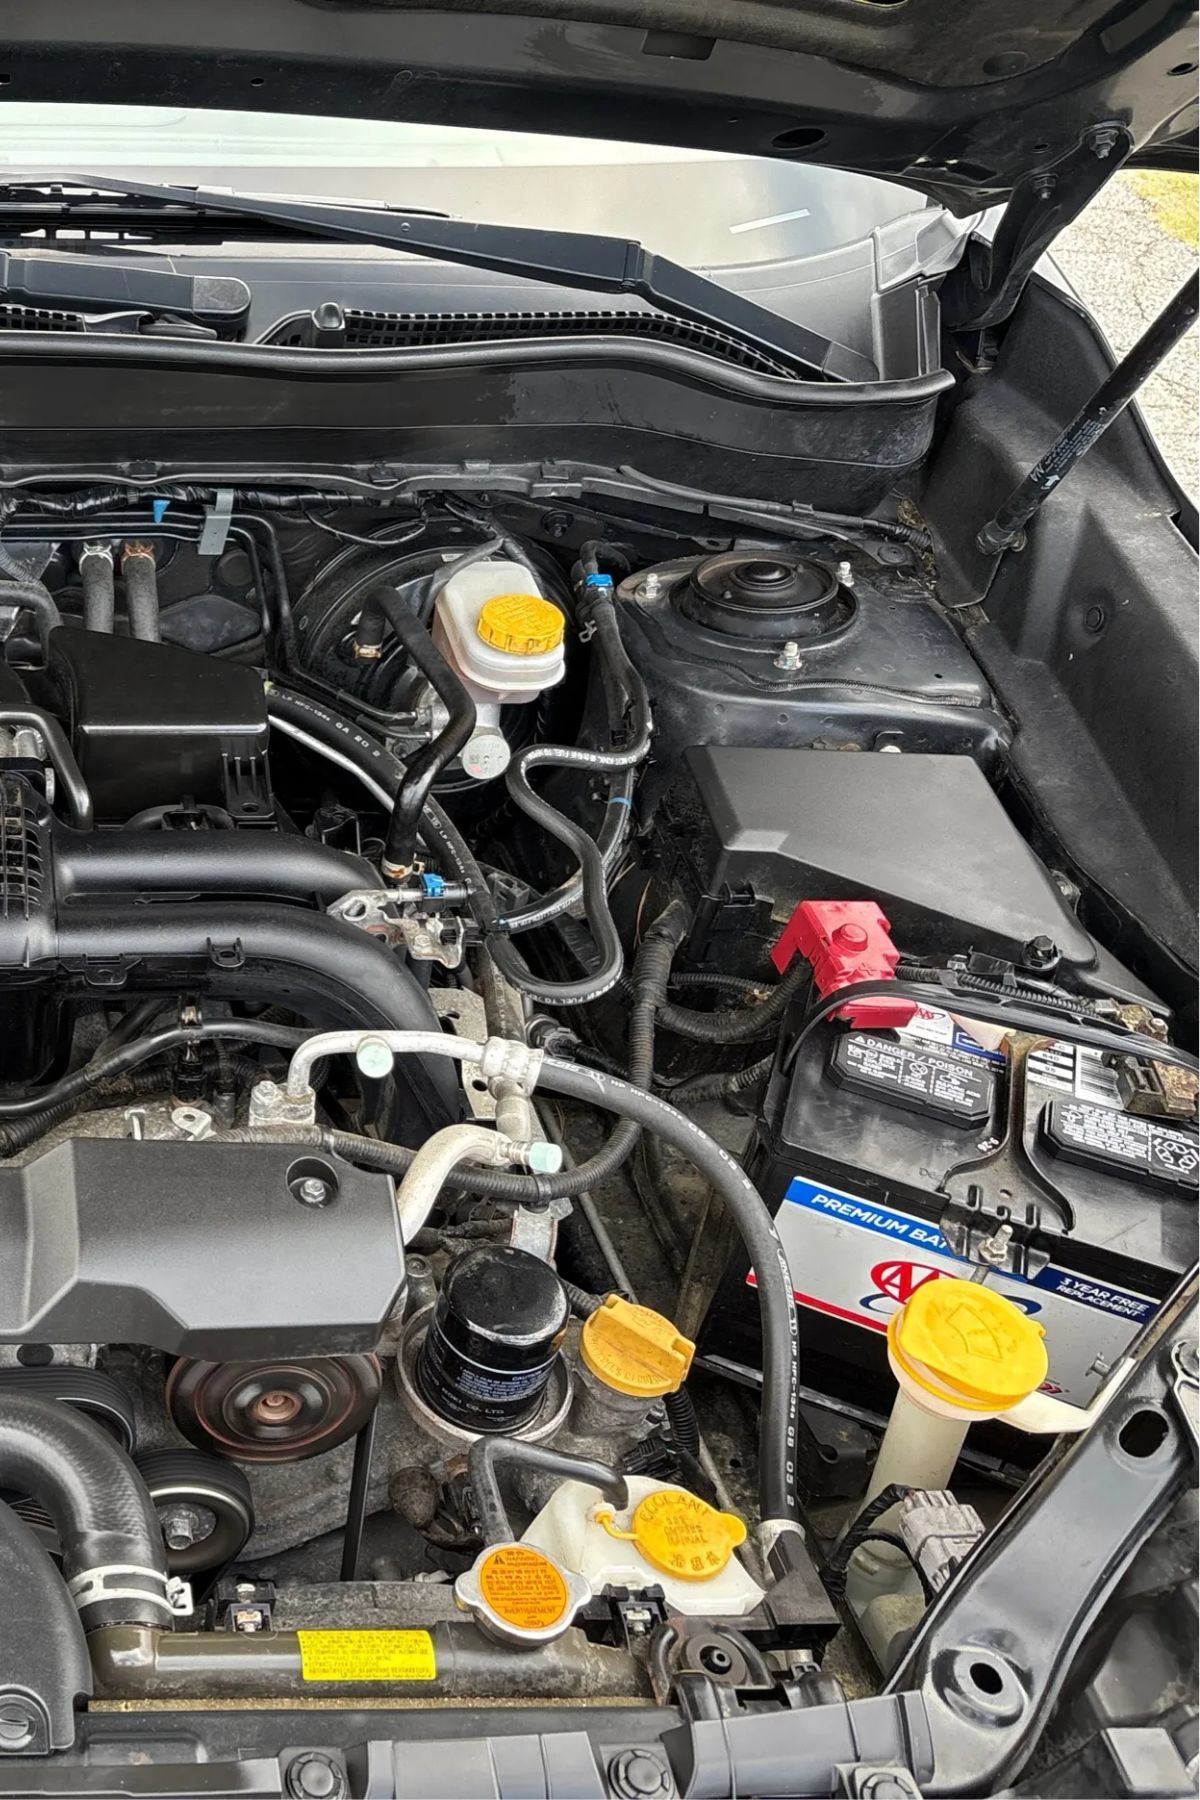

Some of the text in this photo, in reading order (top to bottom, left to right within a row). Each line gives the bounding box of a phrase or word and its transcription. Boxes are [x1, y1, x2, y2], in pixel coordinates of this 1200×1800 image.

[866, 1038, 916, 1060] DANGER
[927, 1057, 974, 1078] POISON
[810, 1193, 910, 1236] PREMIUM
[1055, 1284, 1142, 1318] REPLACEMENT
[1060, 1277, 1150, 1313] 3 YEAR FREE
[639, 1494, 711, 1522] COOLANT
